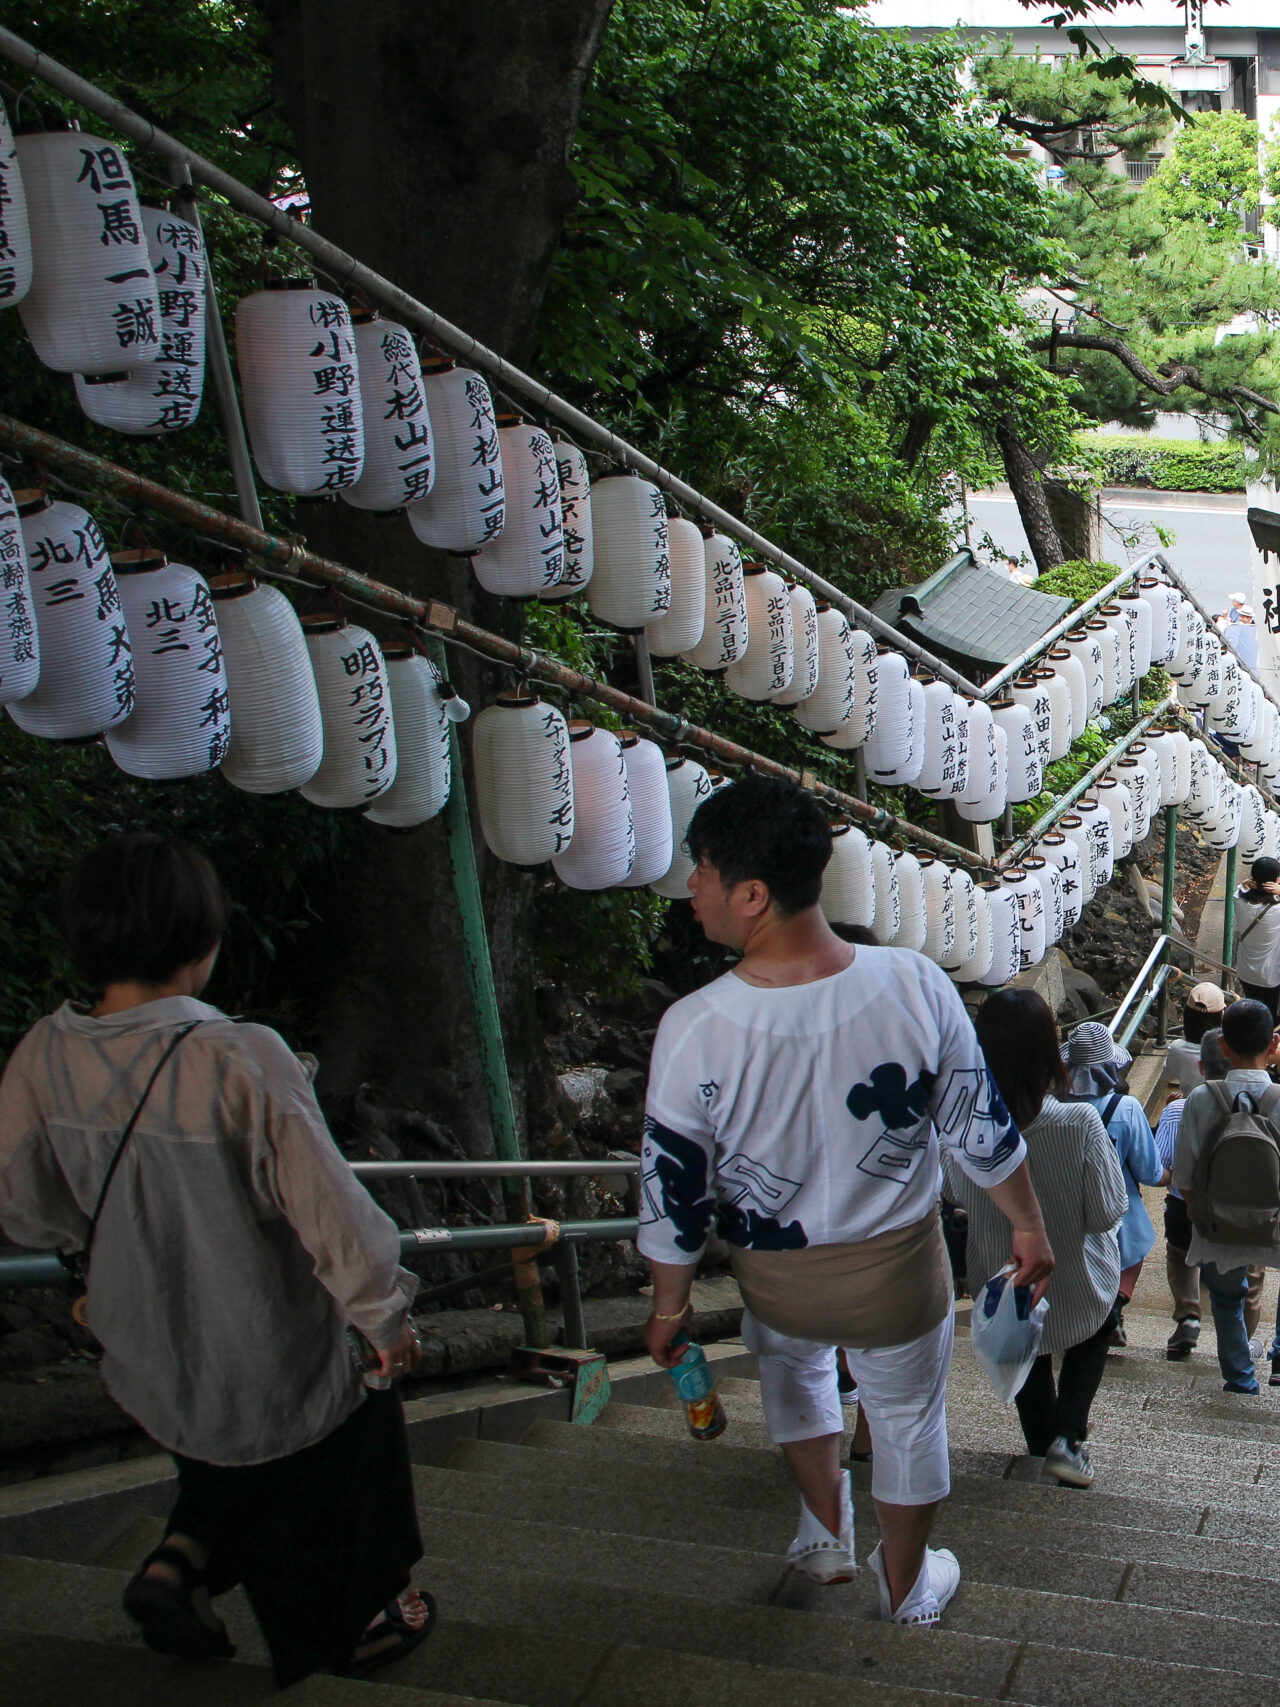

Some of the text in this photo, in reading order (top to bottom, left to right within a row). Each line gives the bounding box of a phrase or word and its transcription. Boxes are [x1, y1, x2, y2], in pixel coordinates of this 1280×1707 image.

[76, 146, 158, 348] 但馬一誠
[380, 331, 432, 503] 総代杉山一男
[464, 377, 505, 545] 総代杉山一男
[528, 434, 564, 587] 総代杉山一男
[0, 529, 36, 662] 高齢者施設
[30, 537, 85, 606] 北三
[147, 597, 190, 655] 北三
[1205, 639, 1219, 696] 北原商店
[940, 704, 955, 781] 高山秀昭
[950, 720, 969, 793] 高山秀昭
[1022, 723, 1041, 793] 高山秀昭
